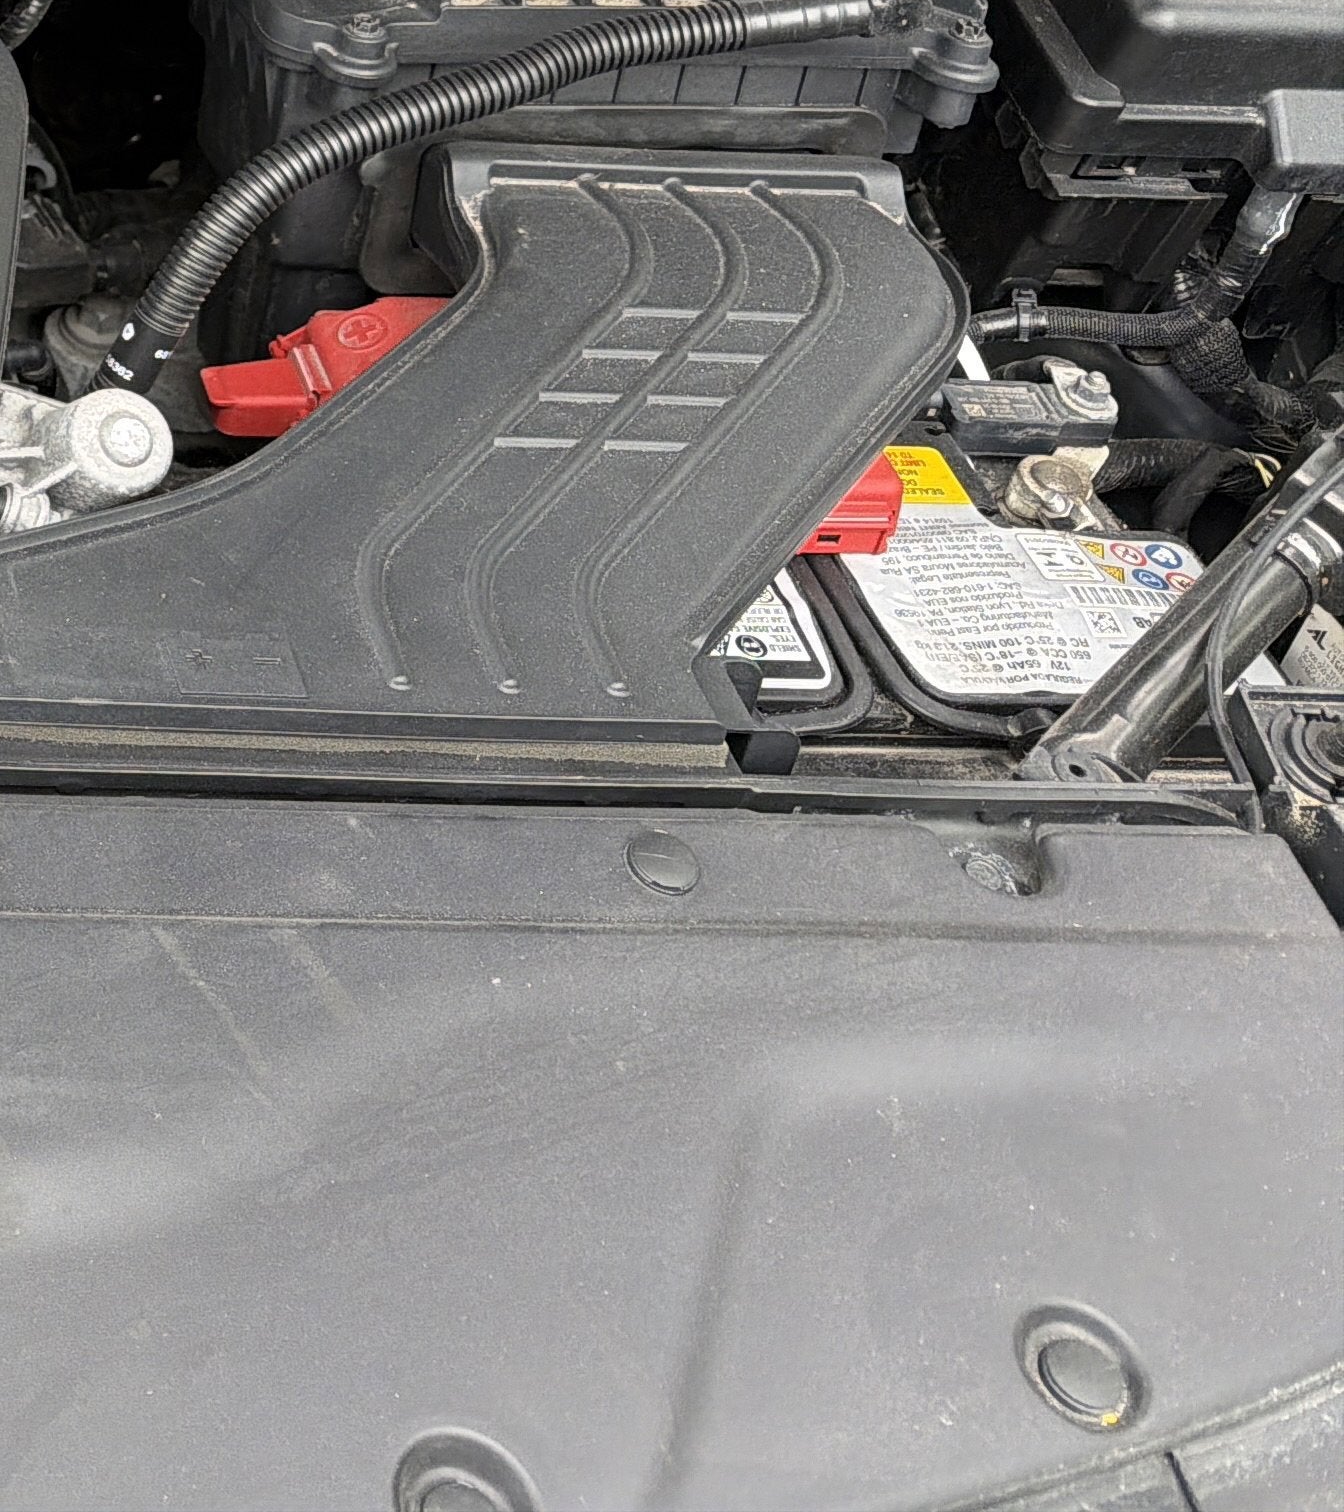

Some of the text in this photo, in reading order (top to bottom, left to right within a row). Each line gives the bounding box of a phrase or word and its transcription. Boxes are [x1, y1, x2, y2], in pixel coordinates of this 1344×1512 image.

[979, 544, 1003, 552] Belo
[881, 556, 901, 565] 195
[904, 566, 919, 574] SA
[921, 563, 955, 575] Moura
[956, 561, 1026, 570] Acumuladores
[970, 591, 1023, 602] Produzido
[923, 598, 947, 606] EUA
[986, 601, 1011, 613] Lyon
[928, 608, 943, 616] PA
[980, 611, 1053, 622] Manufacturing
[926, 617, 950, 627] EUA
[1002, 622, 1054, 631] Produzido
[956, 626, 981, 634] East
[983, 623, 1000, 631] por
[999, 637, 1022, 646] 100
[1070, 637, 1089, 647] RC
[769, 644, 801, 652] SHIELD
[1040, 647, 1067, 658] CCA
[1070, 650, 1091, 660] 650
[992, 664, 1004, 672] @
[1007, 660, 1041, 670] 65Ah
[1050, 660, 1071, 671] 12V
[1006, 674, 1028, 683] POR
